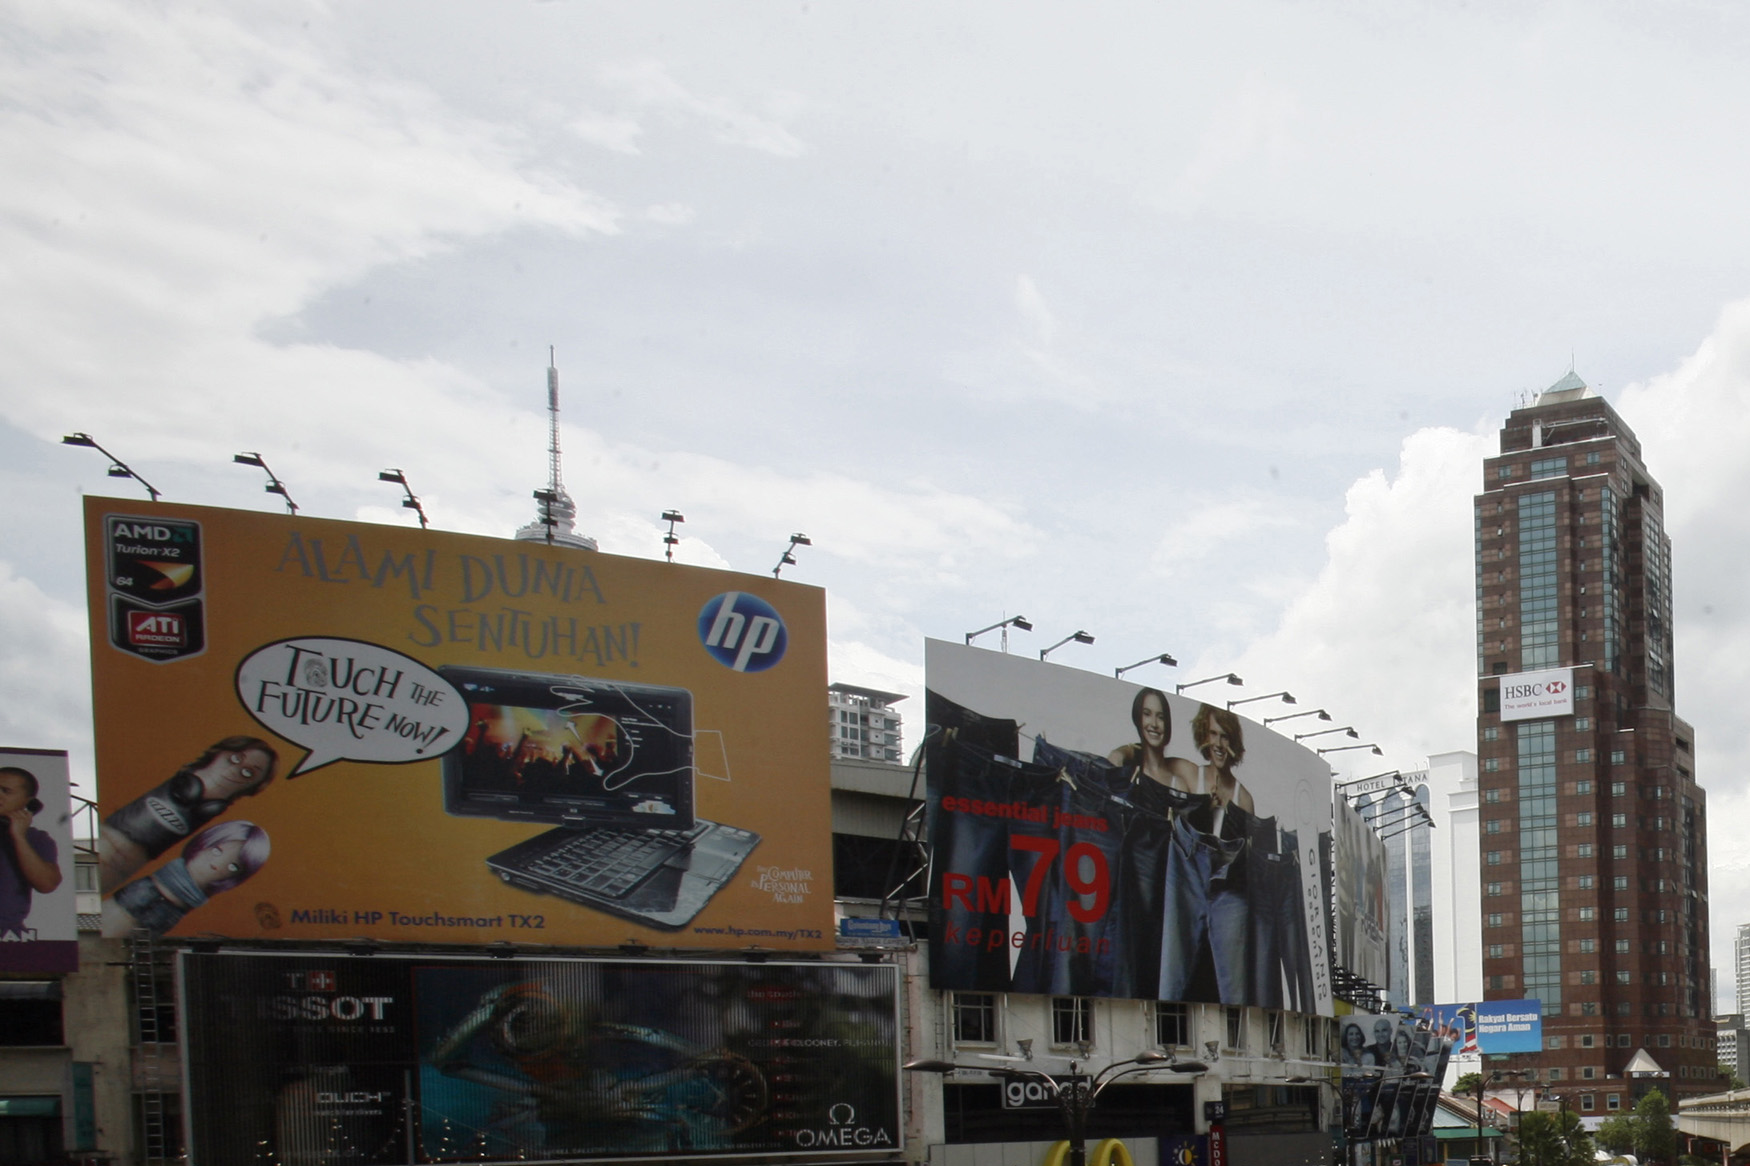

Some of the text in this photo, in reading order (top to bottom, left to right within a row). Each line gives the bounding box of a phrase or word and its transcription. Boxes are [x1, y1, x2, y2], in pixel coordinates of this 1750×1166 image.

[114, 523, 171, 542] AMD
[161, 547, 181, 558] X2
[274, 530, 607, 605] ALAMI DUNIA
[135, 633, 181, 644] RADEON
[408, 604, 643, 669] SENTUHAN!
[706, 590, 780, 673] hp
[410, 682, 446, 707] THE
[1505, 683, 1542, 700] HSBC
[256, 680, 450, 755] FUTURE NOW!
[1357, 773, 1428, 792] HOTEL ITANA
[942, 796, 1110, 833] essential jeans
[760, 873, 812, 894] PERSONAL
[942, 834, 1111, 923] RM 79
[291, 909, 546, 931] Miliki HP Touchsmart TX2
[1307, 848, 1328, 999] GIORDANO
[694, 925, 823, 941] www.hp.com.my/TX2
[945, 921, 1110, 954] keperluan
[1478, 1012, 1538, 1025] Rakyat Bersatu
[1478, 1023, 1531, 1034] Negara Aman
[795, 1127, 893, 1148] OMEGA
